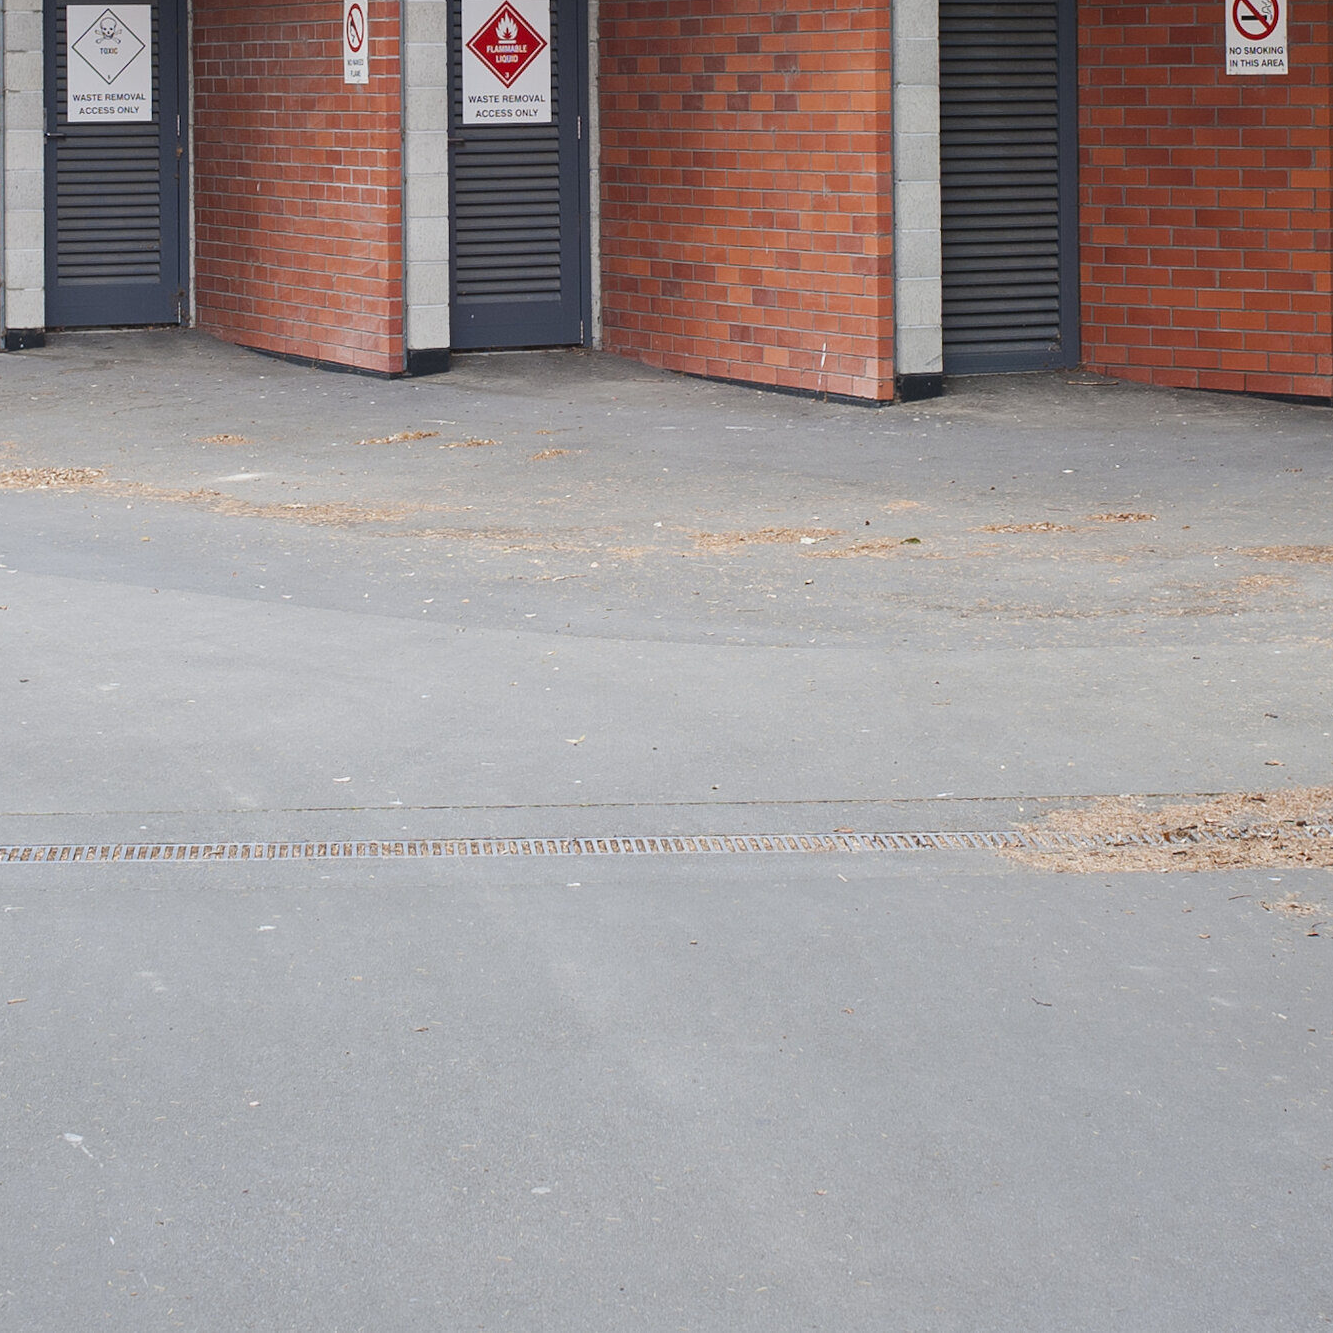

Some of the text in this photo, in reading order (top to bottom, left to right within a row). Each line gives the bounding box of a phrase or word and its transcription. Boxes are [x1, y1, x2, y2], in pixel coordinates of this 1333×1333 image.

[486, 45, 527, 53] FLAMMABLE
[1229, 46, 1284, 55] NO SMOKING
[496, 55, 518, 63] LIQUID
[1230, 59, 1284, 67] IN THIS AREA
[105, 93, 146, 101] REMOVAL
[468, 94, 545, 103] WASTE REMOVAL
[476, 110, 512, 118] ACCESS
